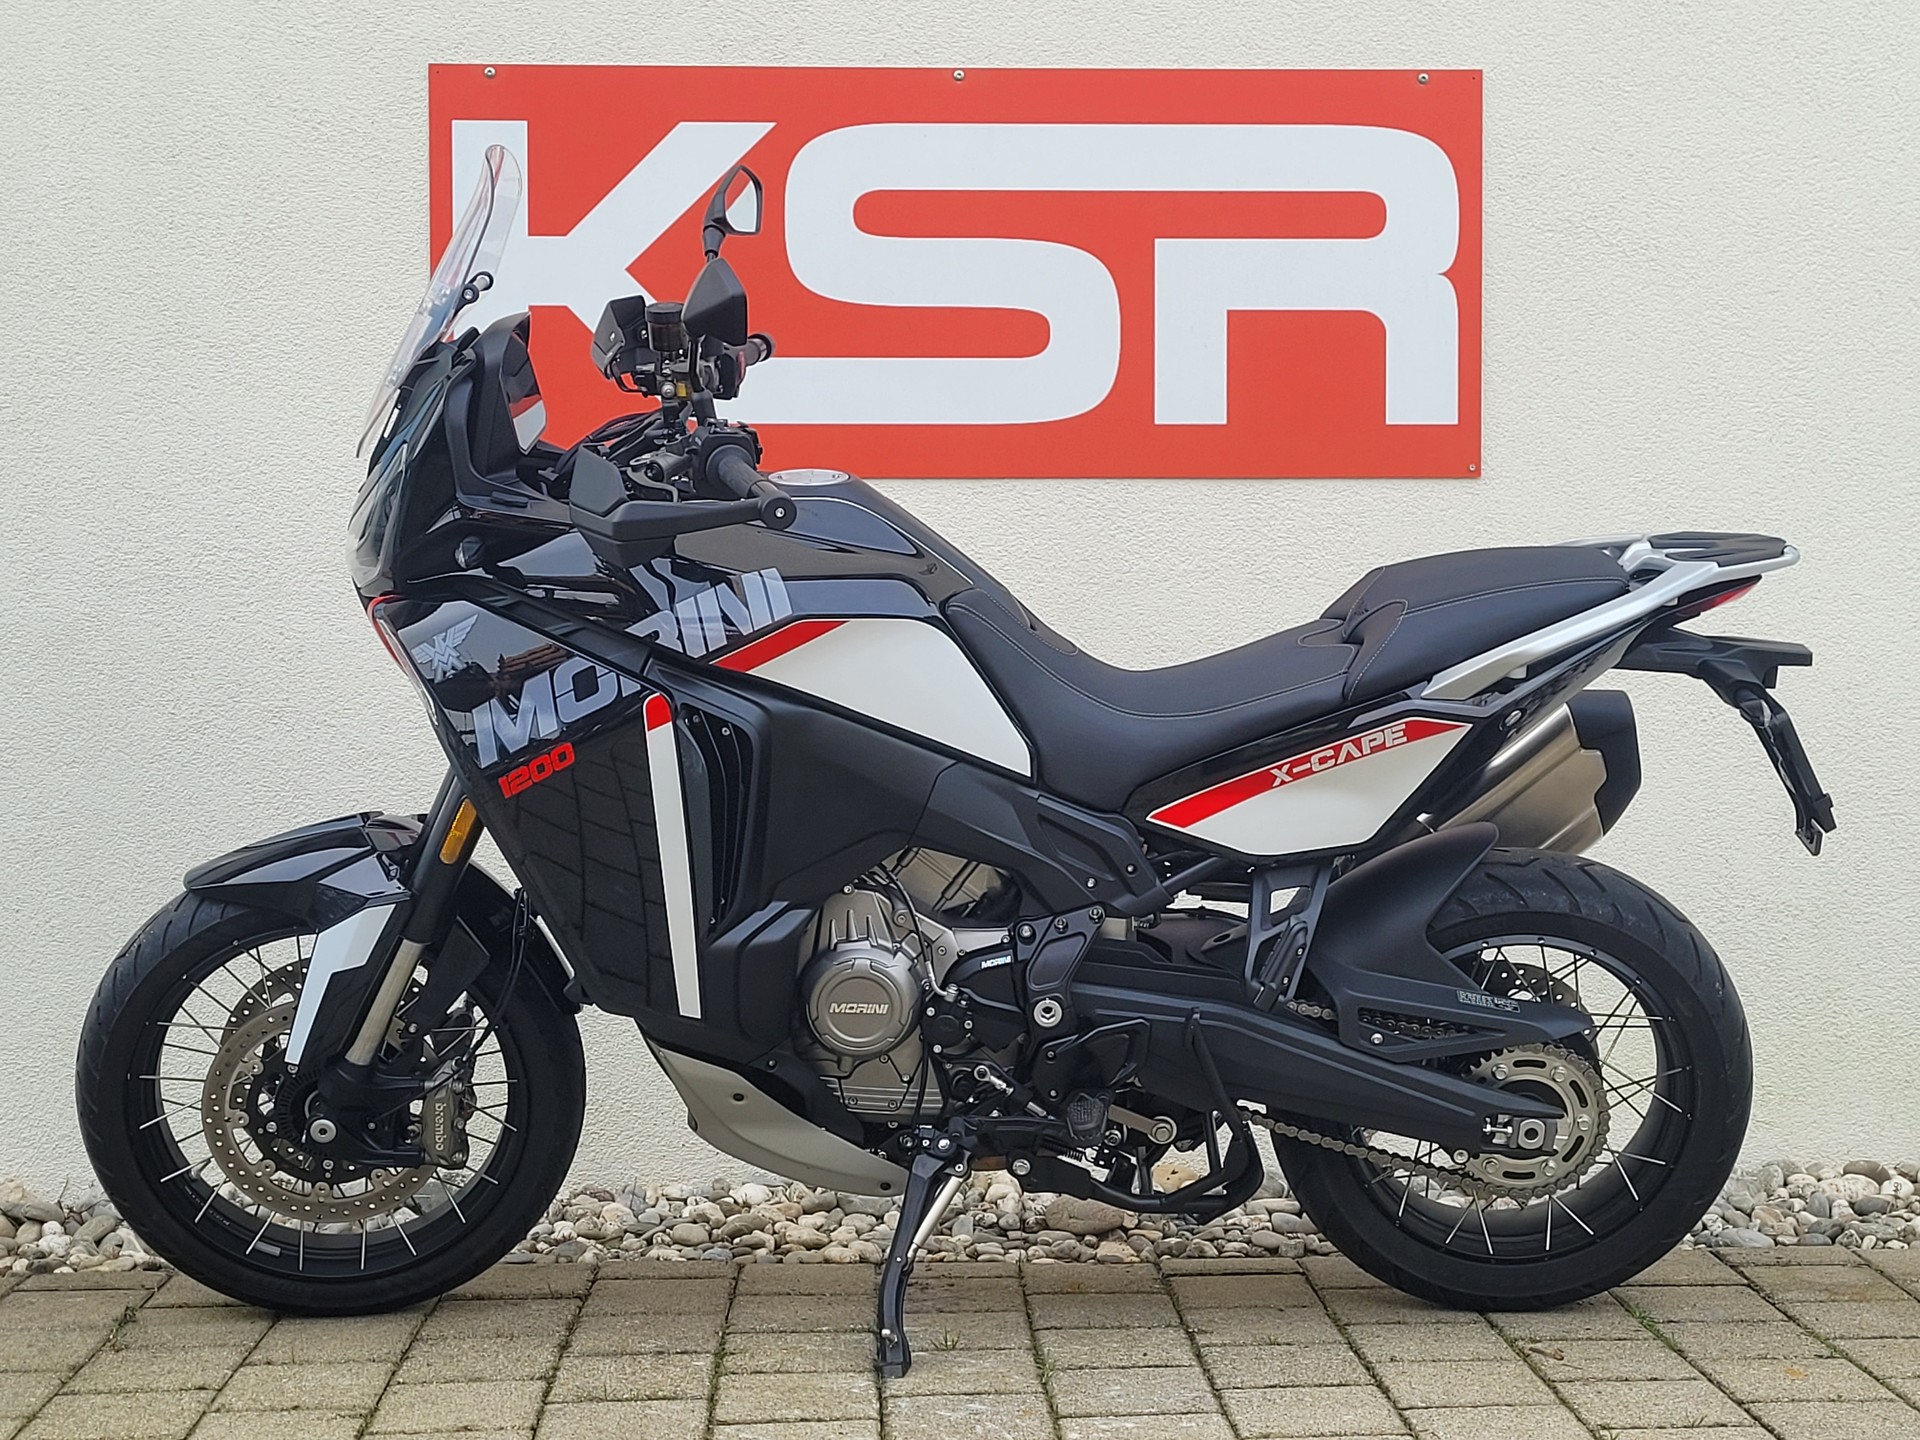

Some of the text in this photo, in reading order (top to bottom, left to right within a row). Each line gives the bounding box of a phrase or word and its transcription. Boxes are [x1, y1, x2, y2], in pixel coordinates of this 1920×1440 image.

[451, 119, 1460, 426] KSR
[498, 742, 576, 799] 1200
[1271, 723, 1408, 788] X-CAPE
[980, 954, 1012, 969] MORINI
[829, 1002, 889, 1015] MORINI
[434, 1102, 447, 1151] brembo
